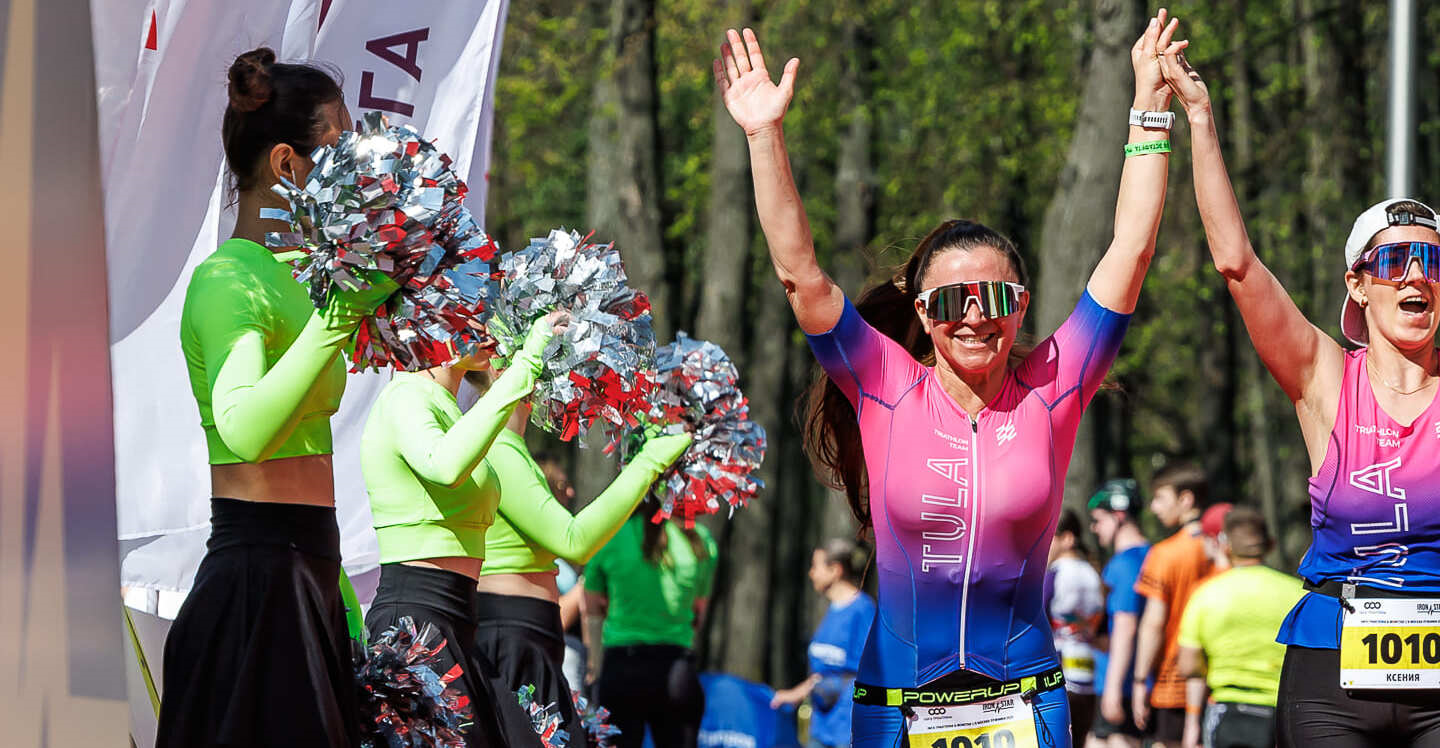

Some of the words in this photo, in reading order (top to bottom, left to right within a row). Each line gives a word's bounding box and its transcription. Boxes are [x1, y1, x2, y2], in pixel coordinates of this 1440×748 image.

[356, 27, 430, 133] ГА
[921, 458, 968, 572] TULA
[904, 683, 1020, 703] POWERUP
[1386, 674, 1420, 682] КСЕНИЯ
